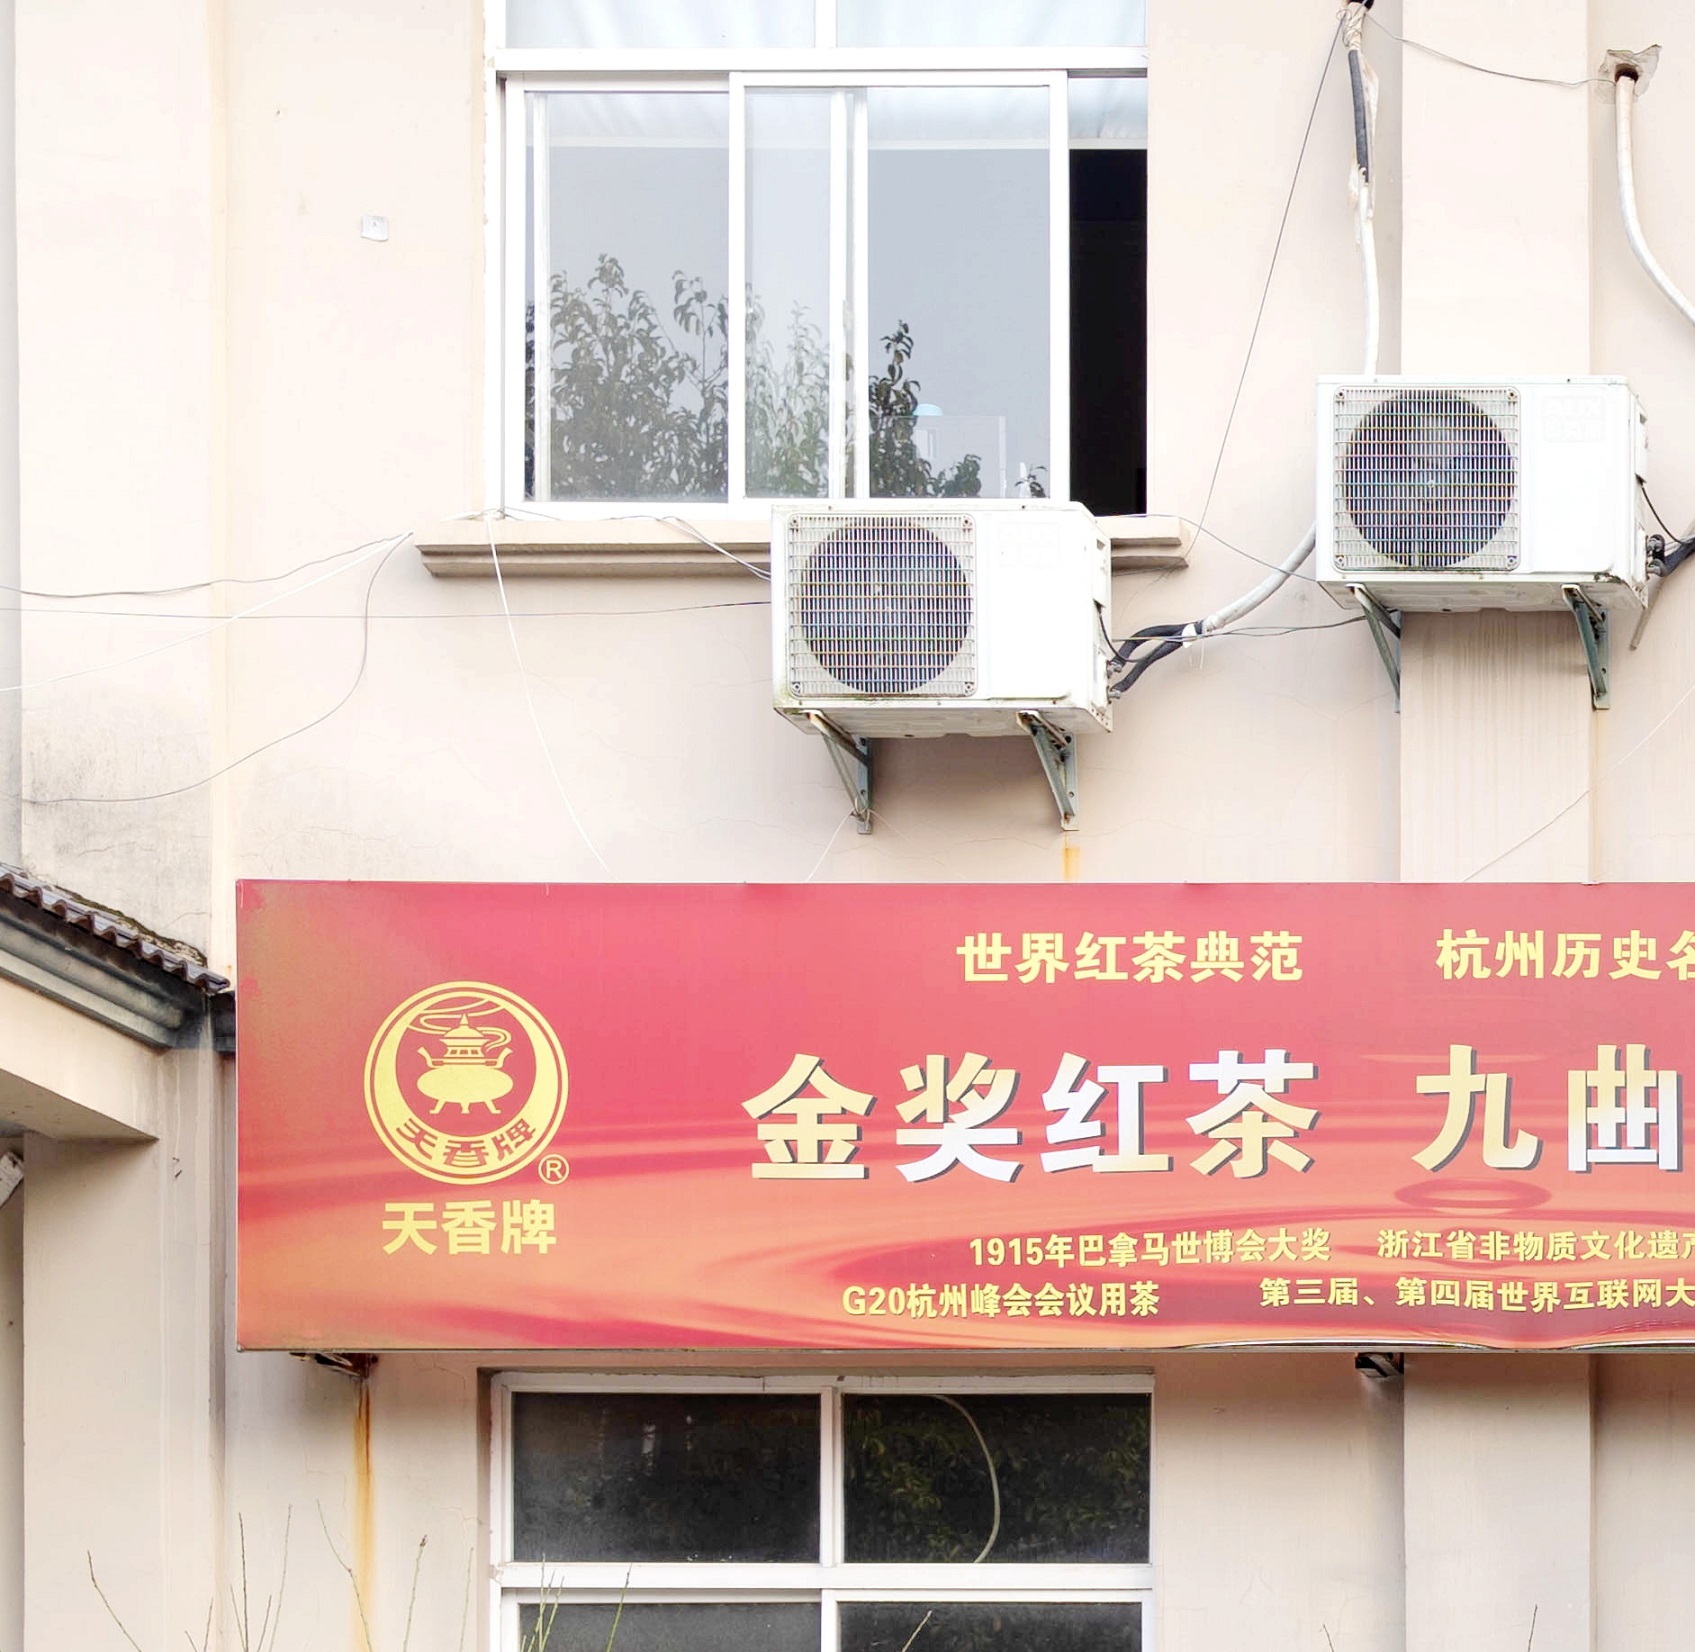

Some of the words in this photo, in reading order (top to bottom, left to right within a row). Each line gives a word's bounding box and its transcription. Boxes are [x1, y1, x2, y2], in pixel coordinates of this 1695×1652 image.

[956, 930, 1304, 985] 世界红茶典范
[741, 1048, 1322, 1184] 金奖红茶
[381, 1198, 558, 1256] 天香牌
[969, 1226, 1332, 1269] 1915年巴拿马世博会大奖
[842, 1280, 1160, 1319] G20杭州峰会会议用茶
